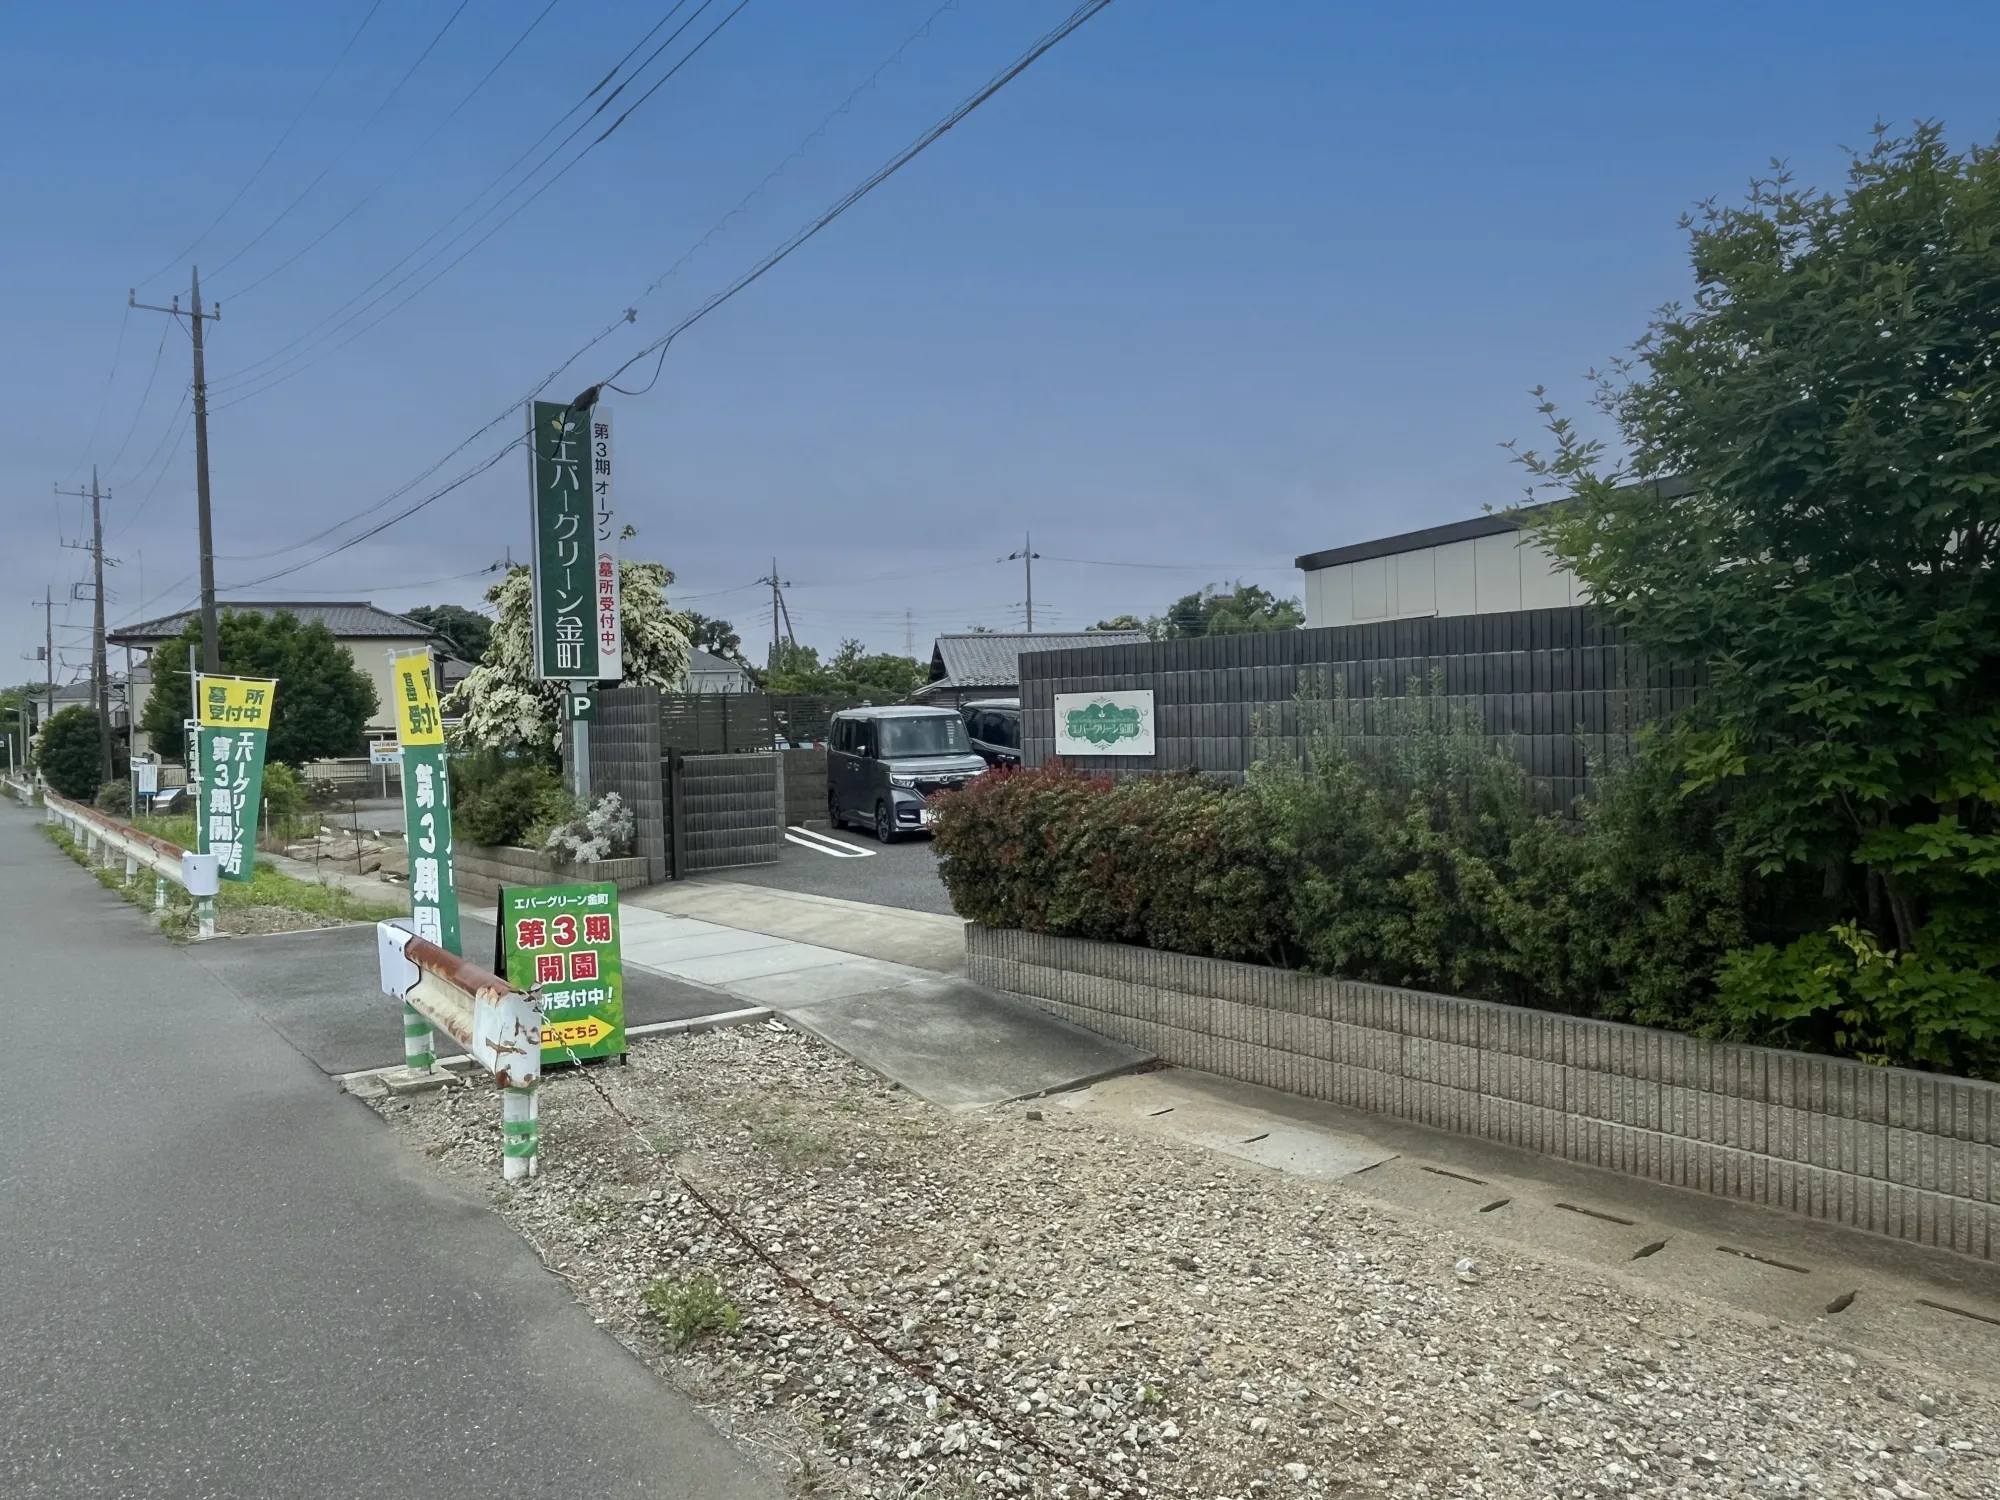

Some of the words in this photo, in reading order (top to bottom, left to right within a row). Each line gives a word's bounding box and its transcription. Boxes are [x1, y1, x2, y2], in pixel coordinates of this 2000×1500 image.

[550, 440, 585, 669] エバーグリーン金町
[209, 704, 262, 722] 受付中
[574, 697, 591, 716] P
[514, 893, 609, 910] エバーグリーン金町
[516, 913, 613, 950] 第3期
[535, 950, 599, 985] 開園
